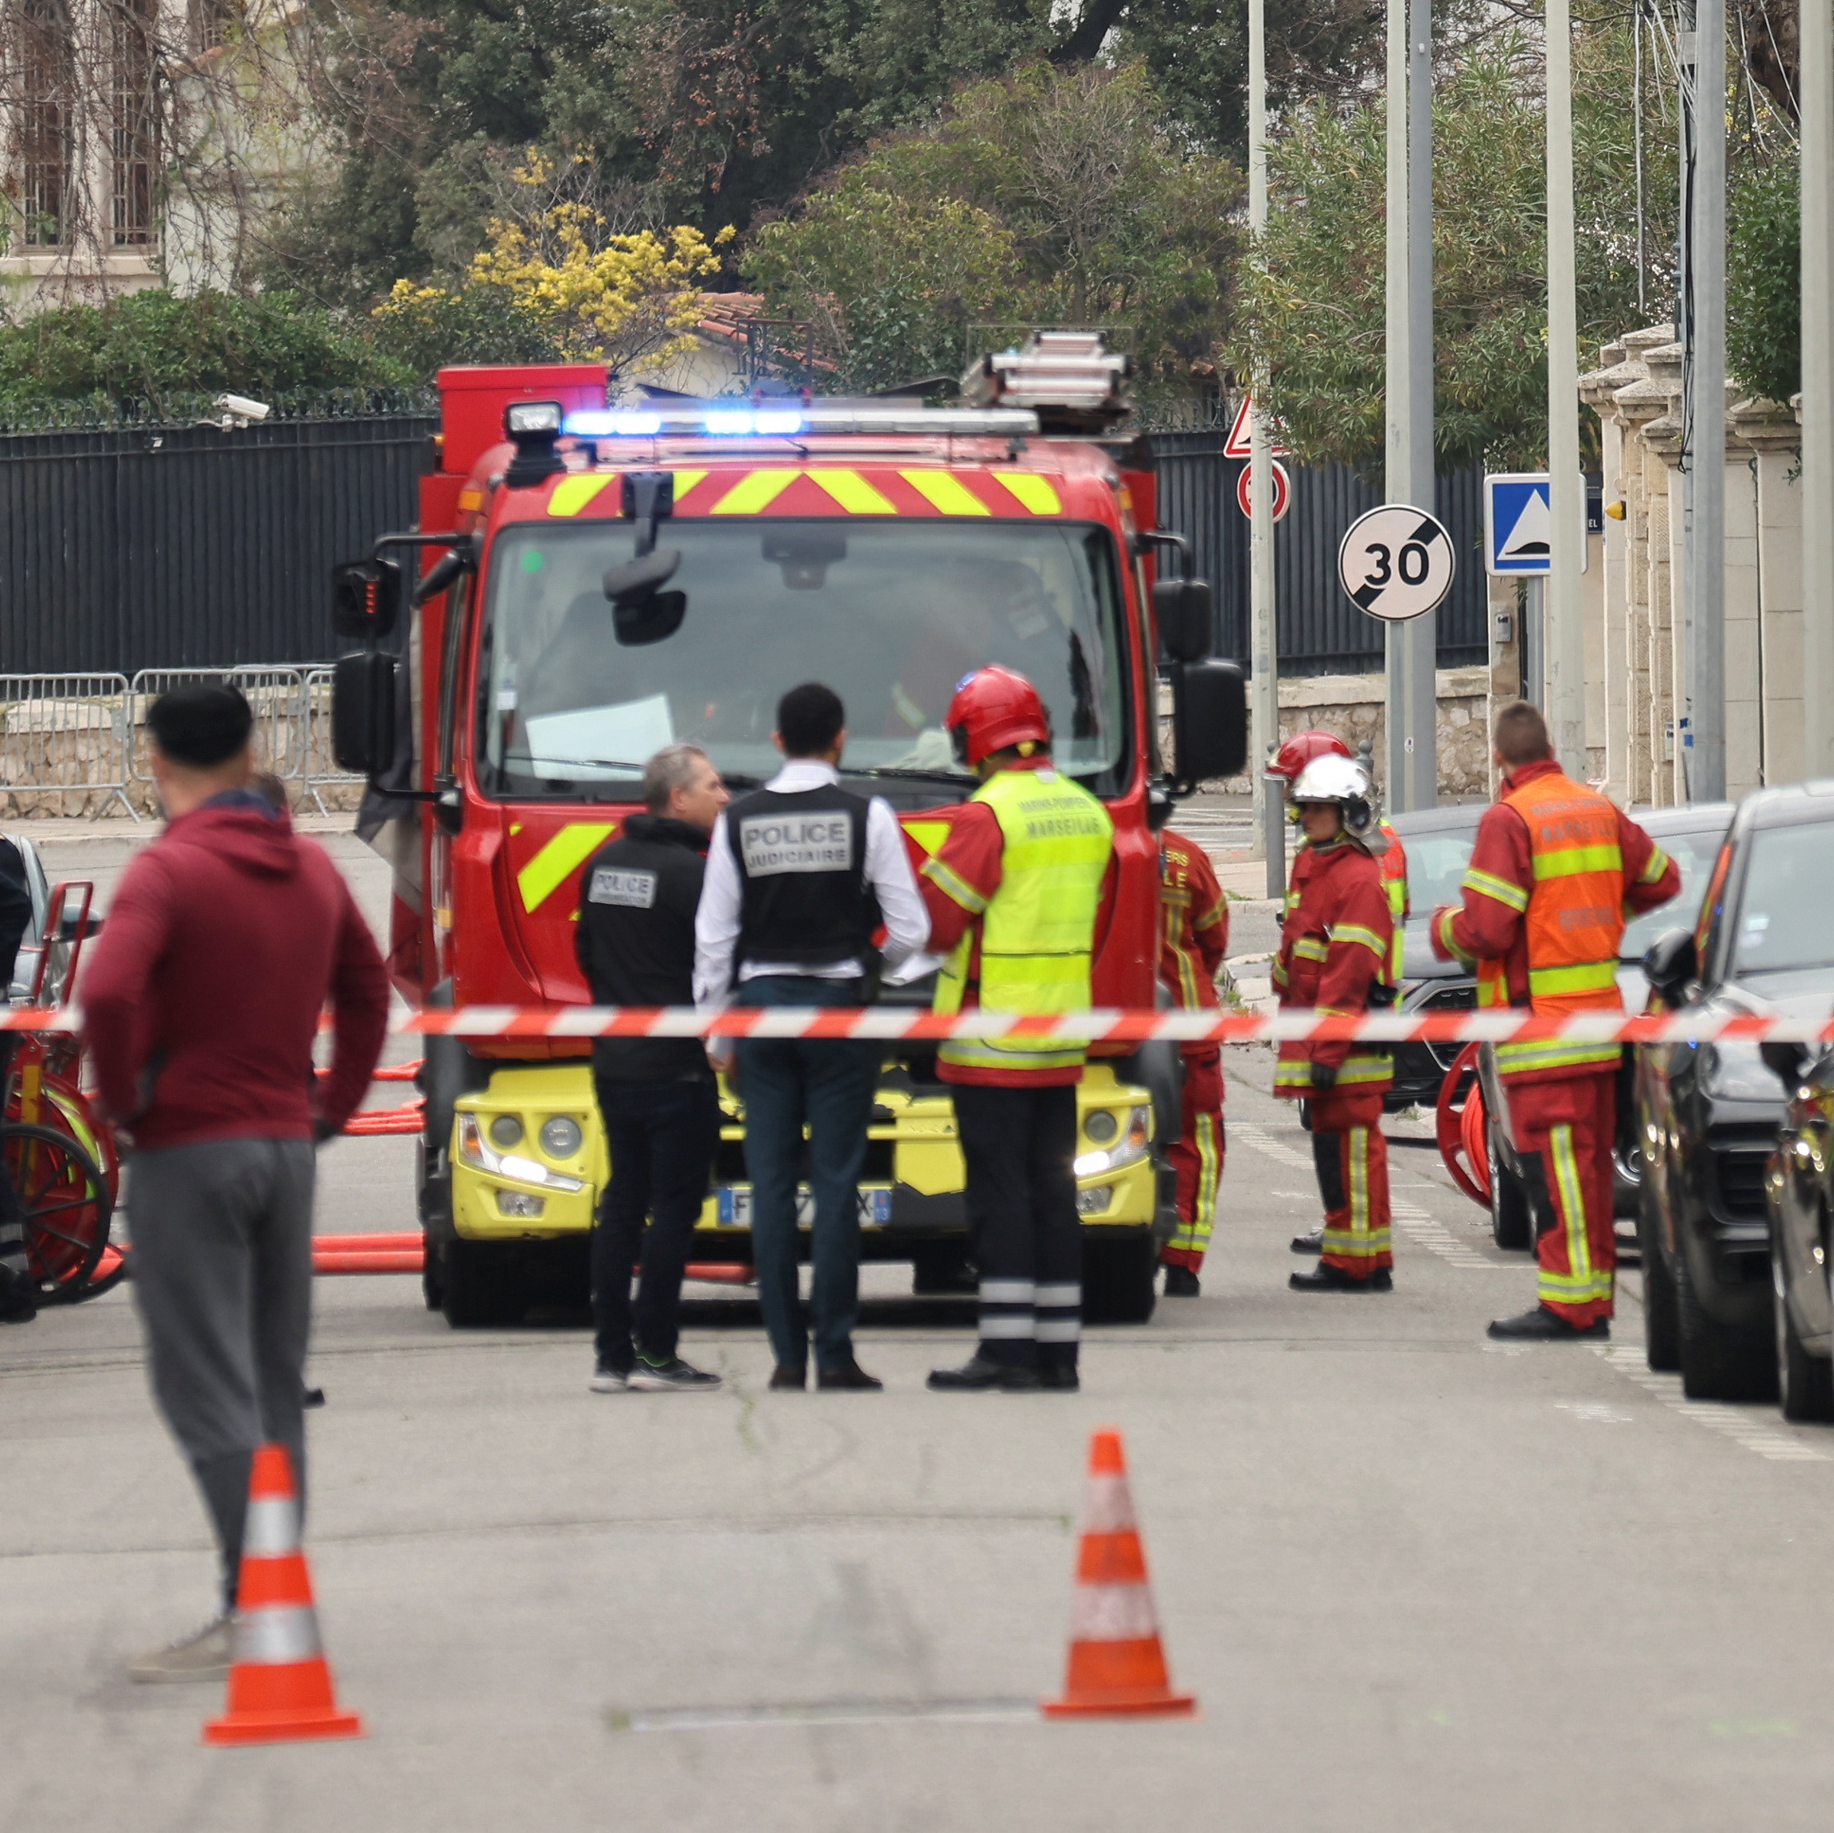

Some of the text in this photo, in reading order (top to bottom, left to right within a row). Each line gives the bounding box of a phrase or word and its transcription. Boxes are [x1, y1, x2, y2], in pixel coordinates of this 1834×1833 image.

[1364, 542, 1429, 586] 30
[744, 822, 846, 850] POLICE
[1026, 817, 1100, 839] MARSEILLE
[747, 849, 846, 868] JUDICIAIRE
[598, 874, 649, 894] POLICE
